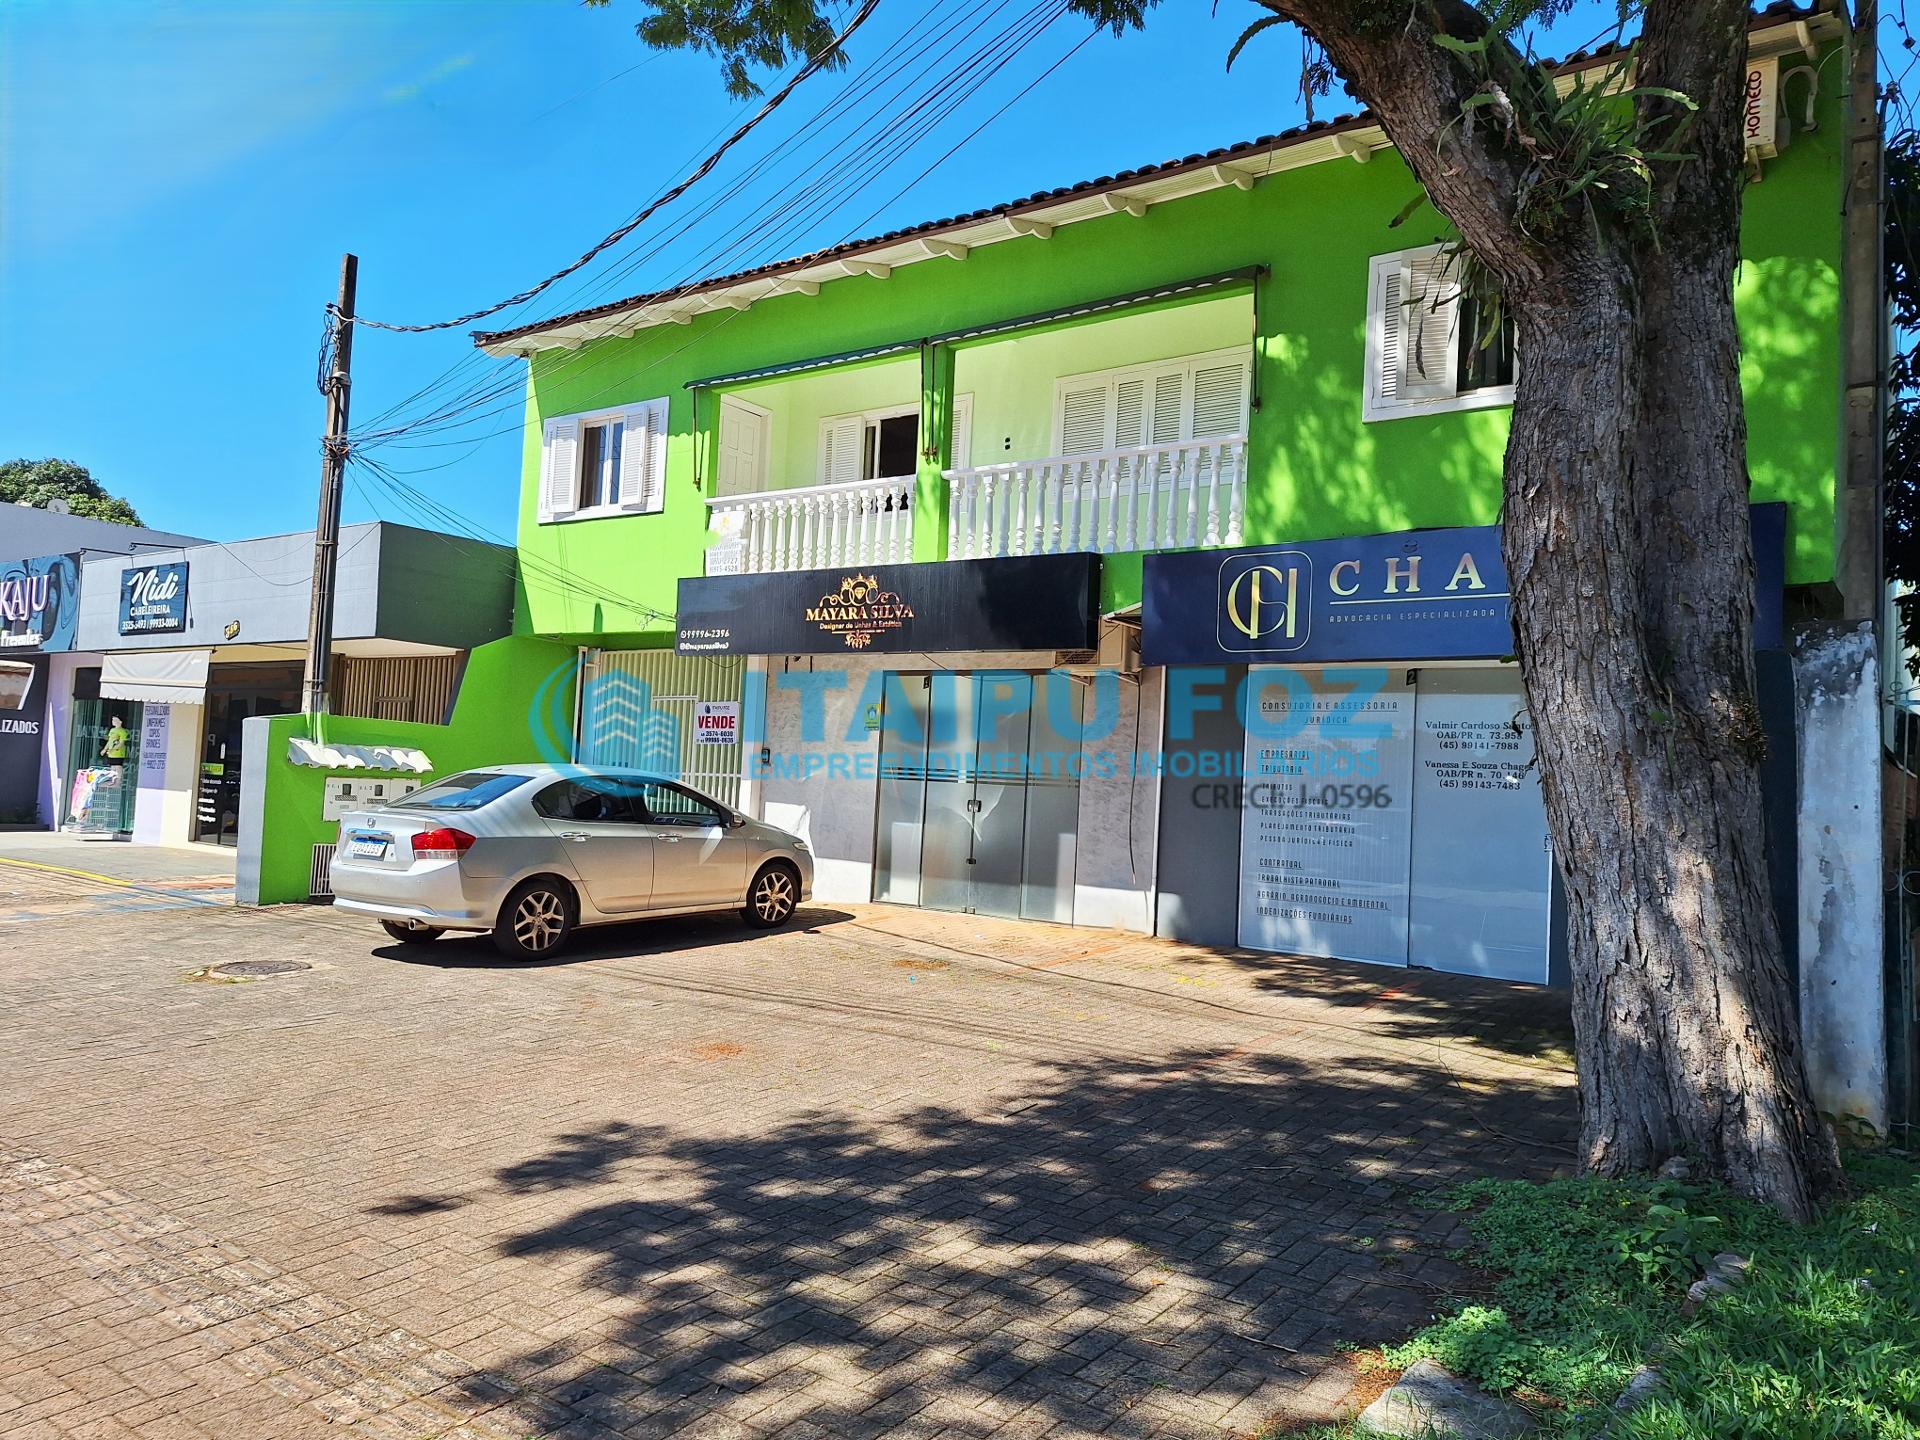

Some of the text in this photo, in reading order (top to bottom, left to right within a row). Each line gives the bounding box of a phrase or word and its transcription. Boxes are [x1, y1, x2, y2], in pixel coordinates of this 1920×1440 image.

[127, 569, 179, 606] Nidi
[130, 605, 170, 617] CABELEIREIRA
[805, 603, 914, 620] MAYARA SILVA
[1329, 608, 1495, 623] ADVOCACIA ESPECIALIZADA
[819, 622, 845, 634] Designer
[1334, 702, 1398, 710] ASSESSORIA
[0, 719, 39, 734] IZADOS
[698, 716, 735, 728] VENDE
[1426, 721, 1458, 730] Valmir
[1461, 721, 1500, 730] Cardoso
[1437, 731, 1473, 740] OAB/PR
[1440, 741, 1519, 751] (45) 99141-7988
[1260, 749, 1310, 760] EMPRESARIAL
[1425, 761, 1459, 769] Vanessa
[1472, 761, 1498, 770] Souza
[1437, 770, 1474, 779] OAB/PR
[1440, 779, 1459, 789] (45)
[1260, 822, 1312, 832] PLANEJAMENTO
[1259, 858, 1302, 868] CONTRATUAL
[1258, 874, 1341, 888] TRABALHISTA PATRONAL
[1347, 898, 1389, 910] AMBIENTAL
